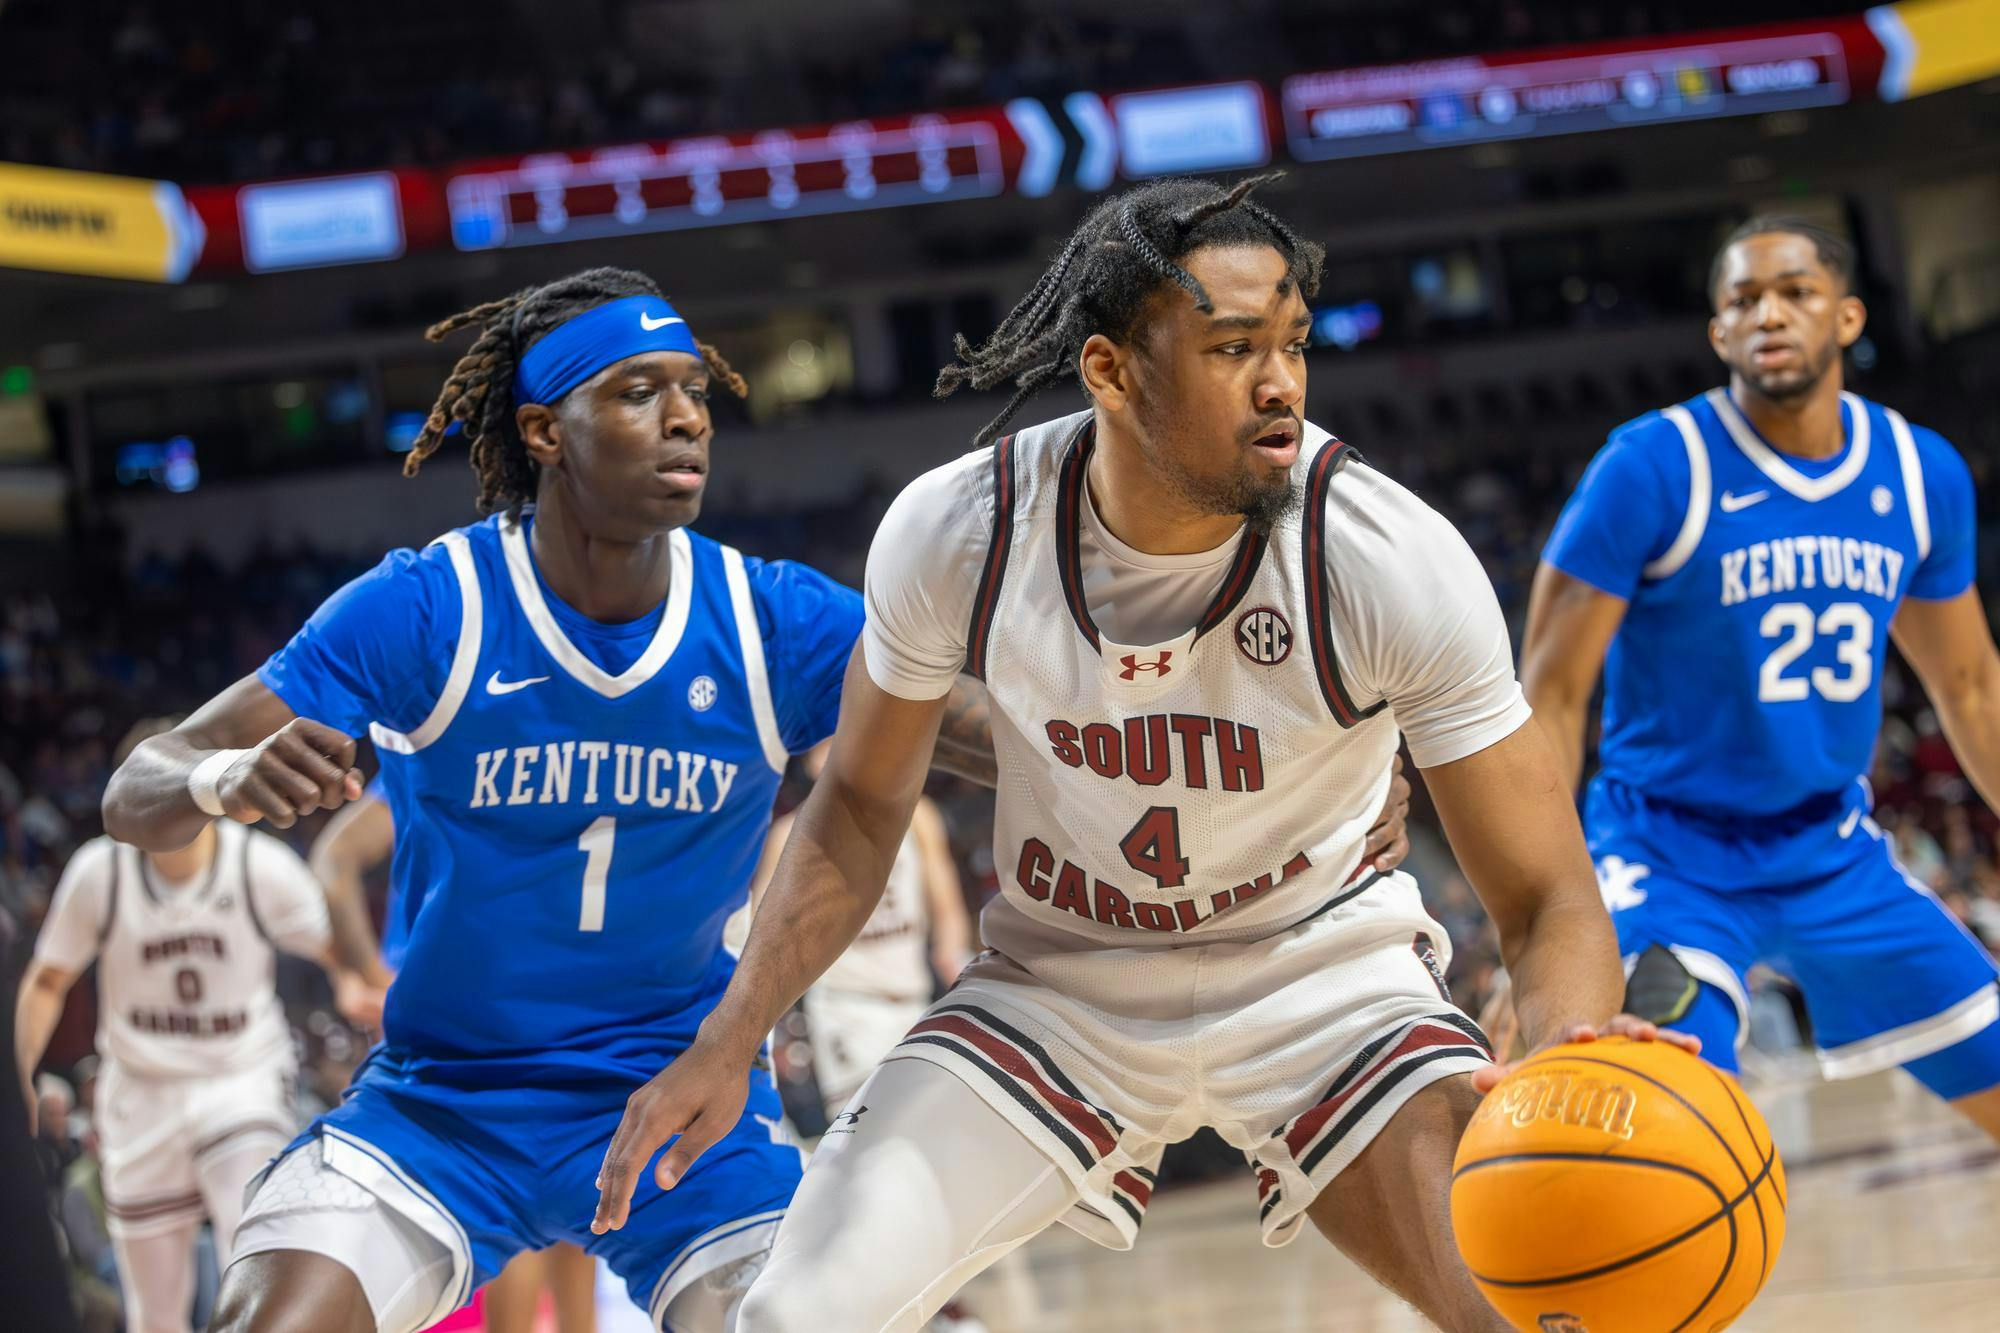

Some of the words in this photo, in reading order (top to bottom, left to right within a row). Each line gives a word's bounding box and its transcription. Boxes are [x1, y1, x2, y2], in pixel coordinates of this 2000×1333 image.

[1720, 535, 1904, 606] KENTUCKY
[1239, 611, 1289, 662] SEC
[1758, 602, 1873, 702] 23
[469, 741, 738, 813] KENTUCKY
[1044, 713, 1264, 792] SOUTH
[578, 816, 616, 932] 1
[1118, 805, 1189, 889] 4
[176, 967, 202, 1004] 0
